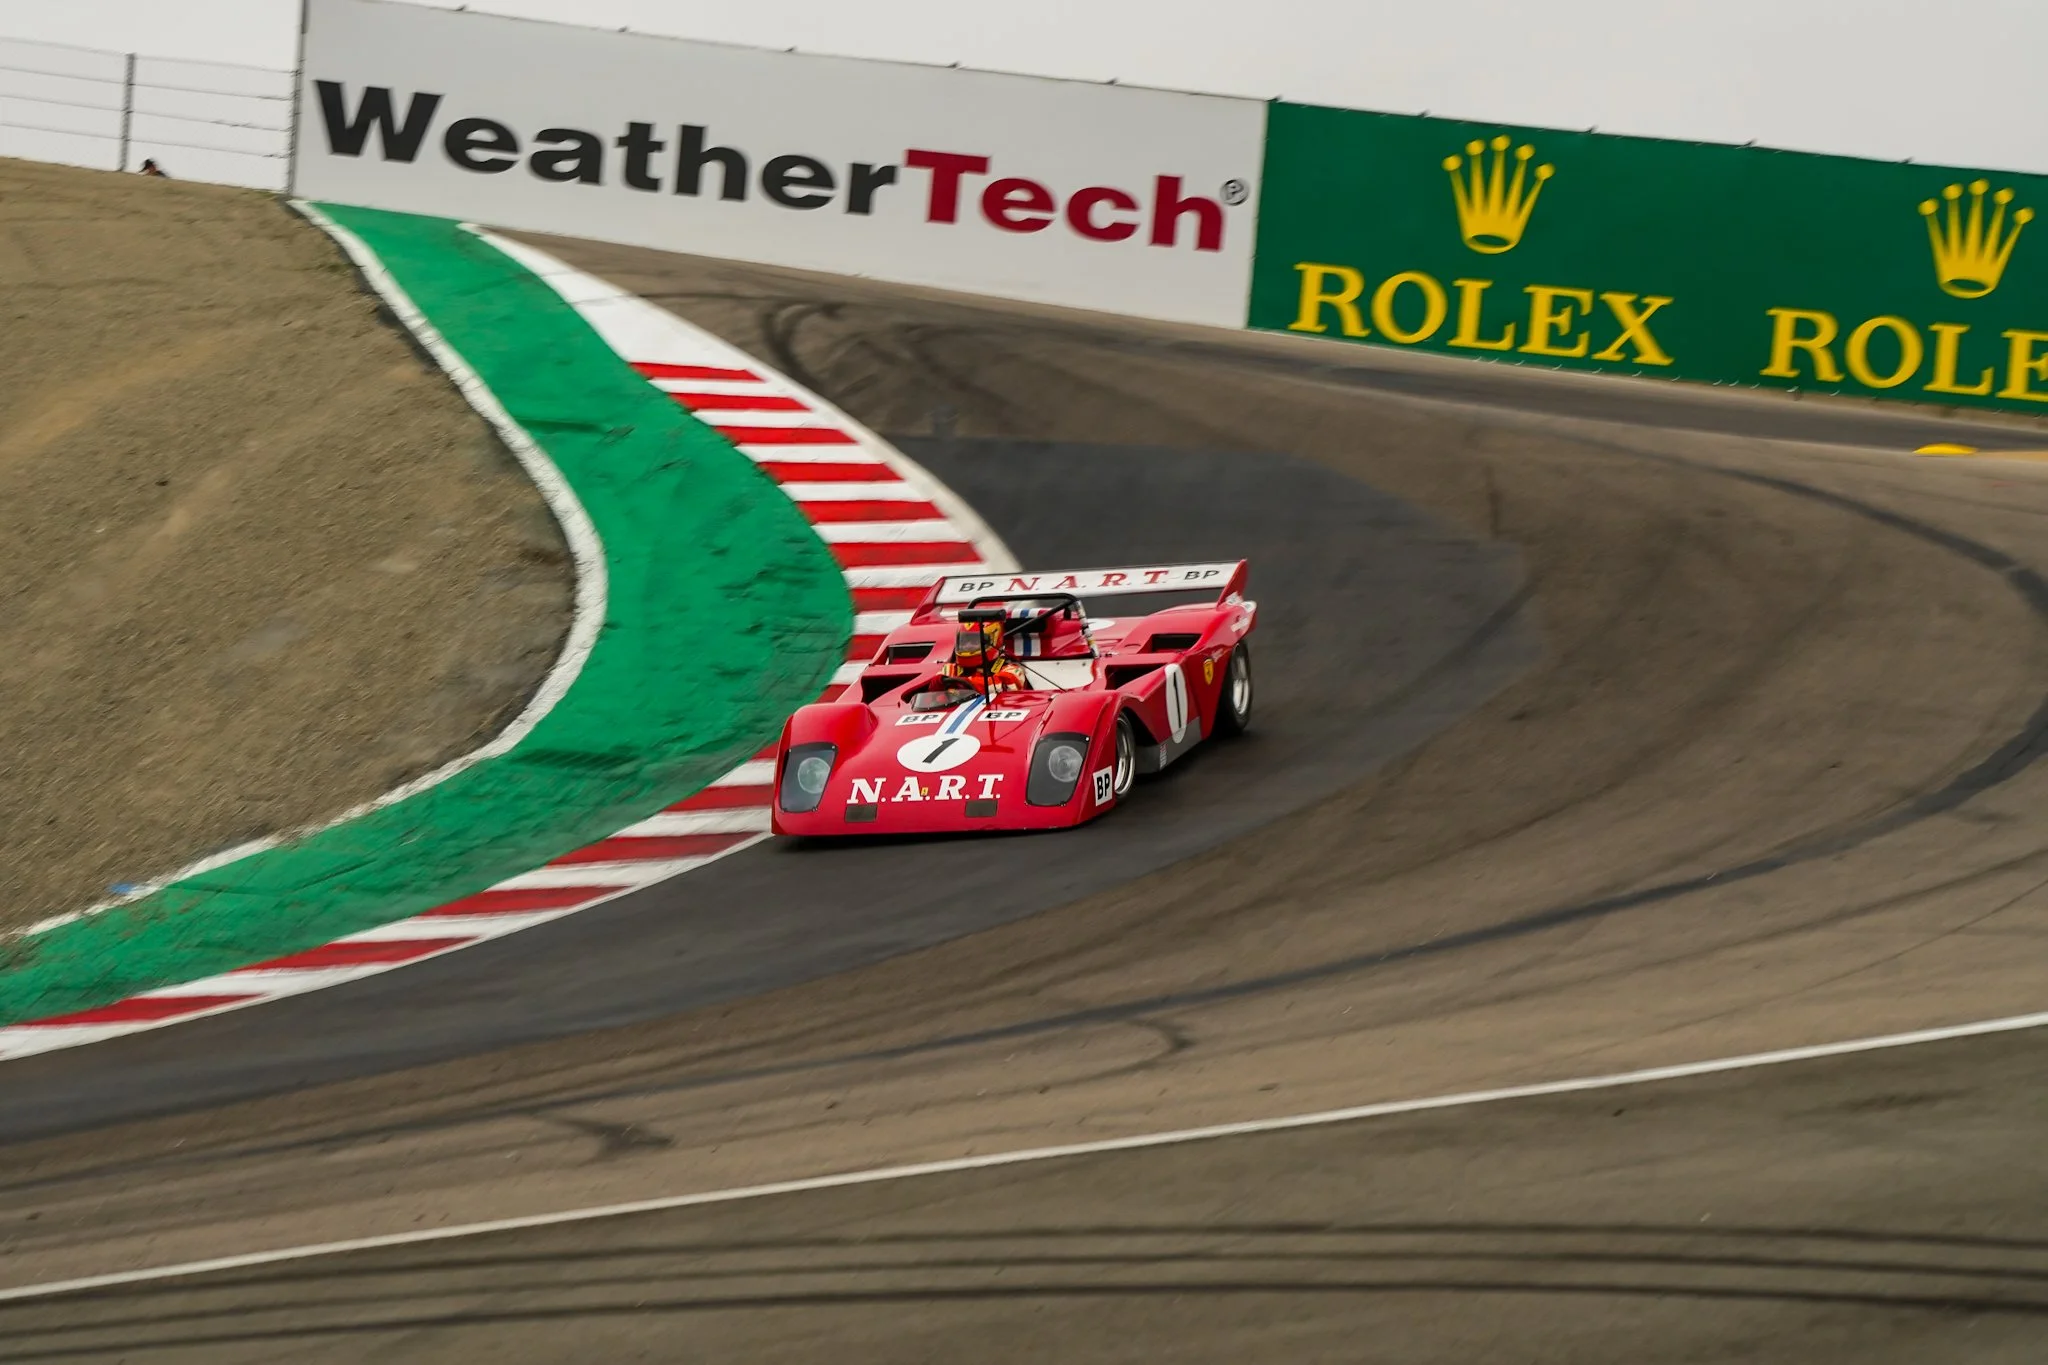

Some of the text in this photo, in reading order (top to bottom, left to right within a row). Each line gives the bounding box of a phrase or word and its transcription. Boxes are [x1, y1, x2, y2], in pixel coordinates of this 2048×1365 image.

[1288, 261, 1676, 368] ROLEX
[958, 581, 994, 592] BP
[1183, 569, 1220, 581] BP
[1172, 671, 1182, 729] 1
[902, 714, 939, 724] BP
[984, 711, 1023, 720] BP
[922, 737, 960, 764] 1
[846, 773, 1005, 804] N.A.R.T.
[1096, 772, 1110, 801] BP
